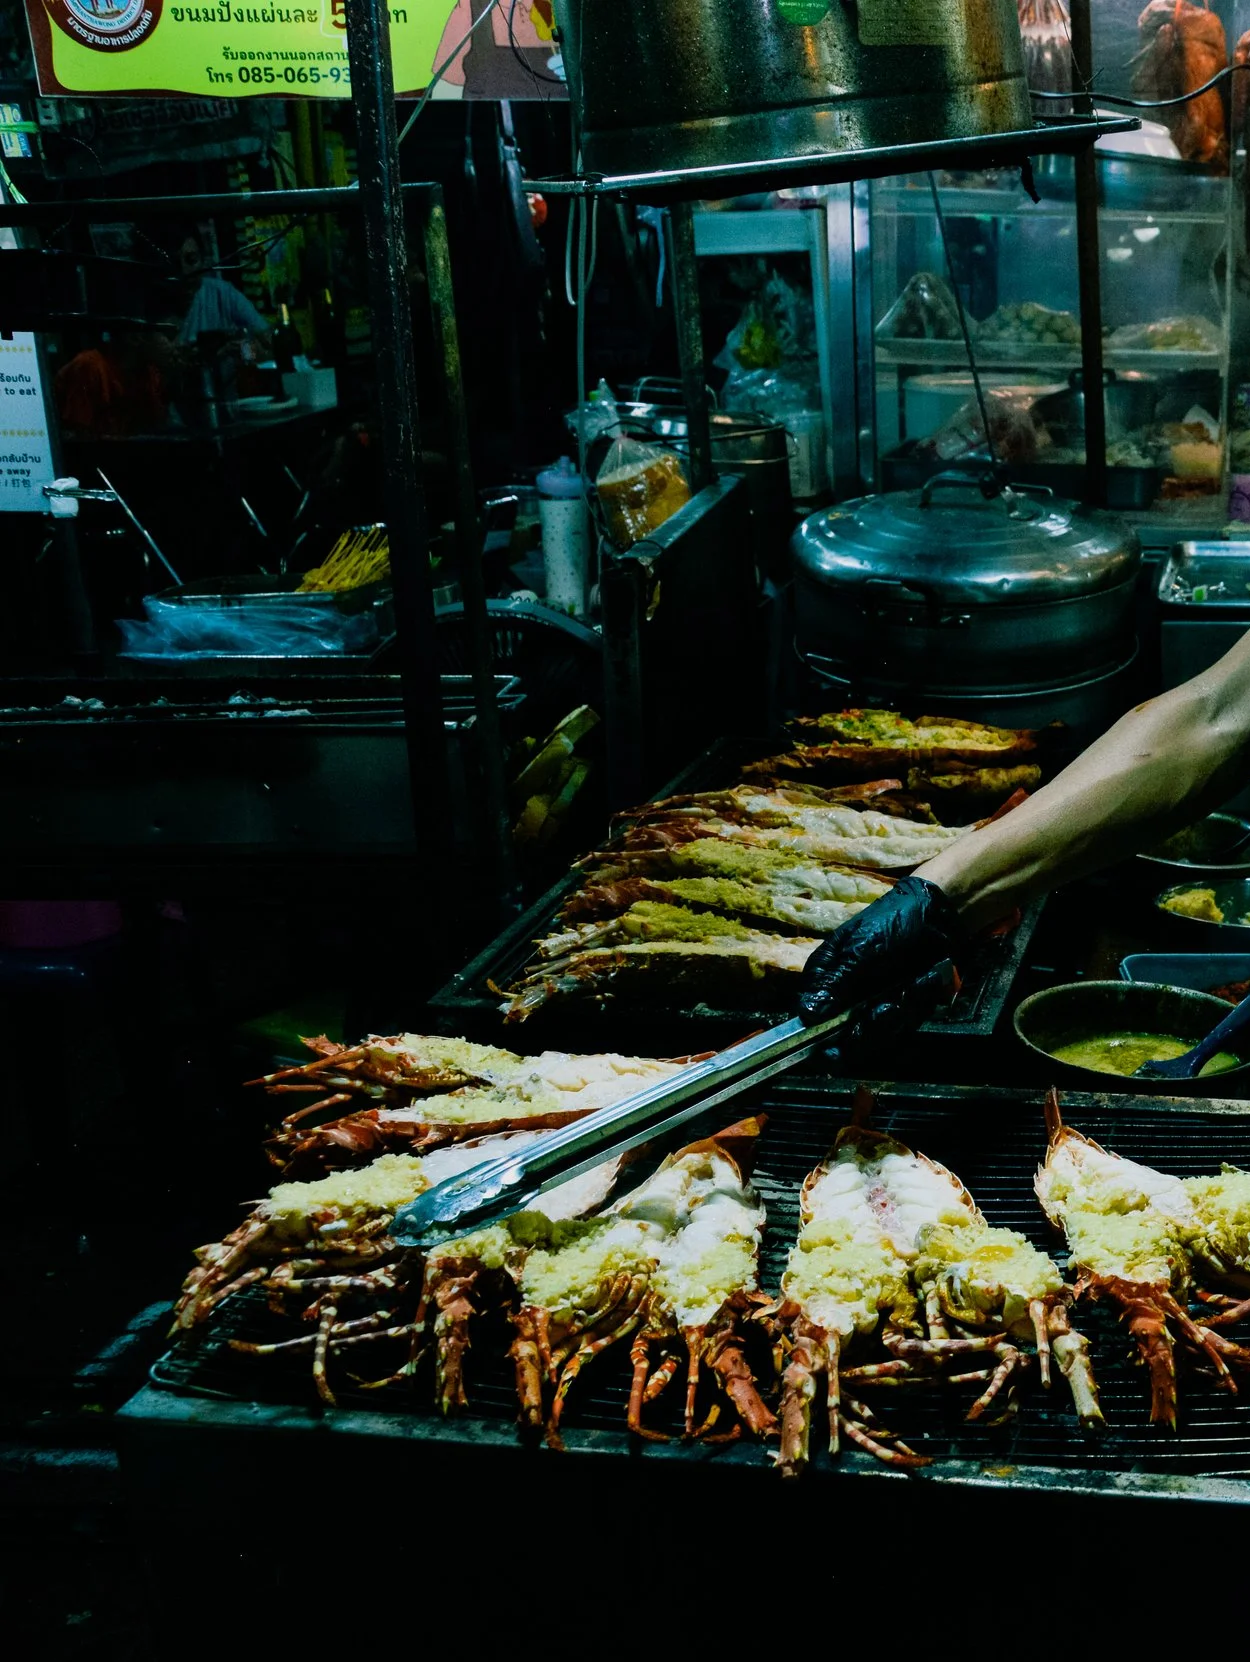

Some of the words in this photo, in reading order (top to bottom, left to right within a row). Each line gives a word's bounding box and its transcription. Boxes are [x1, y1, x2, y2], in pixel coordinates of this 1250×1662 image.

[170, 0, 318, 23] ขนมปังแผ่นละ
[206, 68, 233, 83] โทร
[4, 387, 15, 395] to
[19, 387, 37, 396] eat
[7, 468, 31, 478] away
